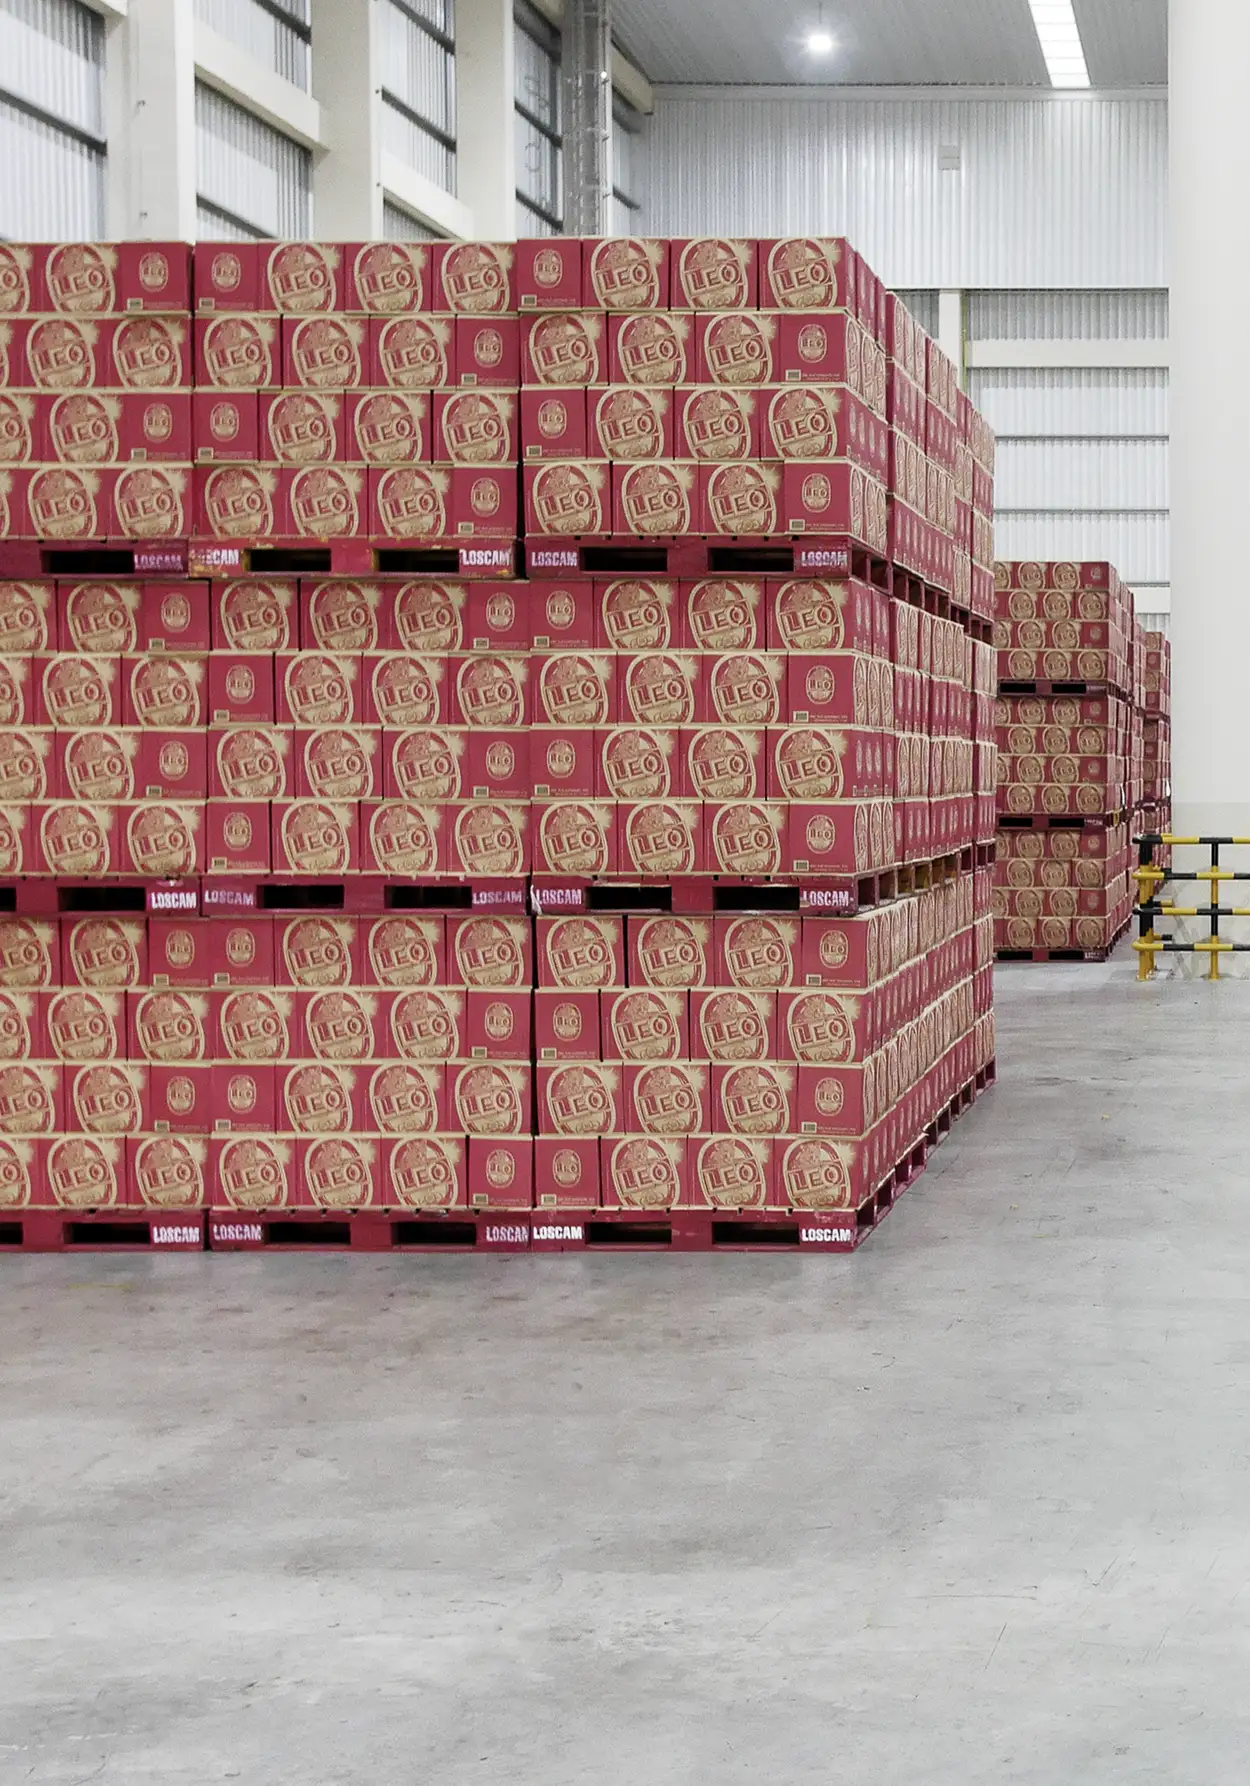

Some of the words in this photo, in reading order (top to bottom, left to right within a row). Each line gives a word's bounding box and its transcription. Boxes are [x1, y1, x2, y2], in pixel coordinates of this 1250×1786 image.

[55, 267, 107, 298] LEO
[276, 266, 328, 297] LEO
[363, 266, 415, 297] LEO
[451, 266, 502, 297] LEO
[600, 262, 651, 293] LEO
[689, 262, 740, 293] LEO
[777, 262, 829, 293] LEO
[35, 342, 87, 373] LEO
[122, 342, 174, 373] LEO
[213, 341, 264, 372] LEO
[301, 342, 353, 373] LEO
[388, 341, 439, 372] LEO
[538, 338, 590, 369] LEO
[626, 338, 678, 369] LEO
[713, 338, 765, 369] LEO
[59, 417, 111, 448] LEO
[277, 416, 328, 447] LEO
[363, 416, 414, 447] LEO
[451, 416, 502, 447] LEO
[605, 412, 656, 443] LEO
[692, 413, 743, 444] LEO
[777, 412, 829, 443] LEO
[37, 492, 89, 523] LEO
[123, 491, 175, 522] LEO
[214, 490, 265, 521] LEO
[300, 491, 351, 522] LEO
[387, 491, 438, 522] LEO
[542, 487, 593, 518] LEO
[630, 488, 682, 519] LEO
[716, 488, 768, 519] LEO
[460, 549, 511, 566] LOSCAM
[531, 551, 578, 566] LOSCAM
[0, 606, 38, 634] EO
[76, 607, 128, 638] LEO
[230, 604, 281, 635] LEO
[319, 605, 370, 636] LEO
[404, 605, 455, 636] LEO
[611, 604, 662, 635] LEO
[697, 604, 748, 635] LEO
[784, 604, 836, 635] LEO
[52, 680, 103, 711] LEO
[139, 681, 191, 712] LEO
[294, 678, 345, 709] LEO
[381, 679, 432, 710] LEO
[466, 680, 517, 711] LEO
[549, 678, 600, 709] LEO
[634, 678, 686, 709] LEO
[720, 678, 771, 709] LEO
[0, 755, 38, 782] EO
[74, 755, 126, 786] LEO
[226, 752, 278, 783] LEO
[313, 752, 365, 783] LEO
[401, 754, 453, 785] LEO
[611, 752, 662, 783] LEO
[697, 752, 748, 783] LEO
[784, 753, 836, 784] LEO
[49, 828, 101, 859] LEO
[136, 828, 188, 859] LEO
[291, 825, 342, 856] LEO
[379, 826, 430, 857] LEO
[464, 827, 515, 858] LEO
[549, 827, 600, 858] LEO
[635, 827, 687, 858] LEO
[721, 827, 773, 858] LEO
[151, 891, 197, 909] LOSCAM
[204, 889, 254, 906] LOSCAM
[472, 891, 521, 904] LOSCAM
[536, 889, 582, 905] LOSCAM
[803, 890, 849, 906] LOSCAM
[0, 943, 42, 970] EO
[79, 942, 131, 973] LEO
[292, 941, 343, 972] LEO
[377, 941, 429, 972] LEO
[464, 941, 516, 972] LEO
[556, 942, 608, 973] LEO
[647, 941, 698, 972] LEO
[733, 942, 785, 973] LEO
[57, 1014, 108, 1045] LEO
[145, 1015, 196, 1046] LEO
[230, 1014, 281, 1045] LEO
[315, 1014, 366, 1045] LEO
[400, 1013, 451, 1044] LEO
[620, 1015, 672, 1046] LEO
[709, 1015, 760, 1046] LEO
[796, 1017, 848, 1048] LEO
[0, 1088, 47, 1118] EO
[82, 1087, 133, 1118] LEO
[293, 1087, 344, 1118] LEO
[379, 1087, 430, 1118] LEO
[464, 1088, 515, 1119] LEO
[556, 1089, 607, 1120] LEO
[643, 1088, 694, 1119] LEO
[730, 1088, 781, 1119] LEO
[57, 1160, 108, 1191] LEO
[144, 1160, 195, 1191] LEO
[228, 1161, 279, 1192] LEO
[314, 1161, 365, 1192] LEO
[399, 1161, 450, 1192] LEO
[620, 1161, 672, 1192] LEO
[706, 1161, 758, 1192] LEO
[791, 1163, 843, 1194] LEO
[153, 1226, 200, 1243] LOSCAM
[213, 1224, 262, 1241] LOSCAM
[533, 1226, 583, 1240] LOSCAM
[801, 1228, 851, 1242] LOSCAM
